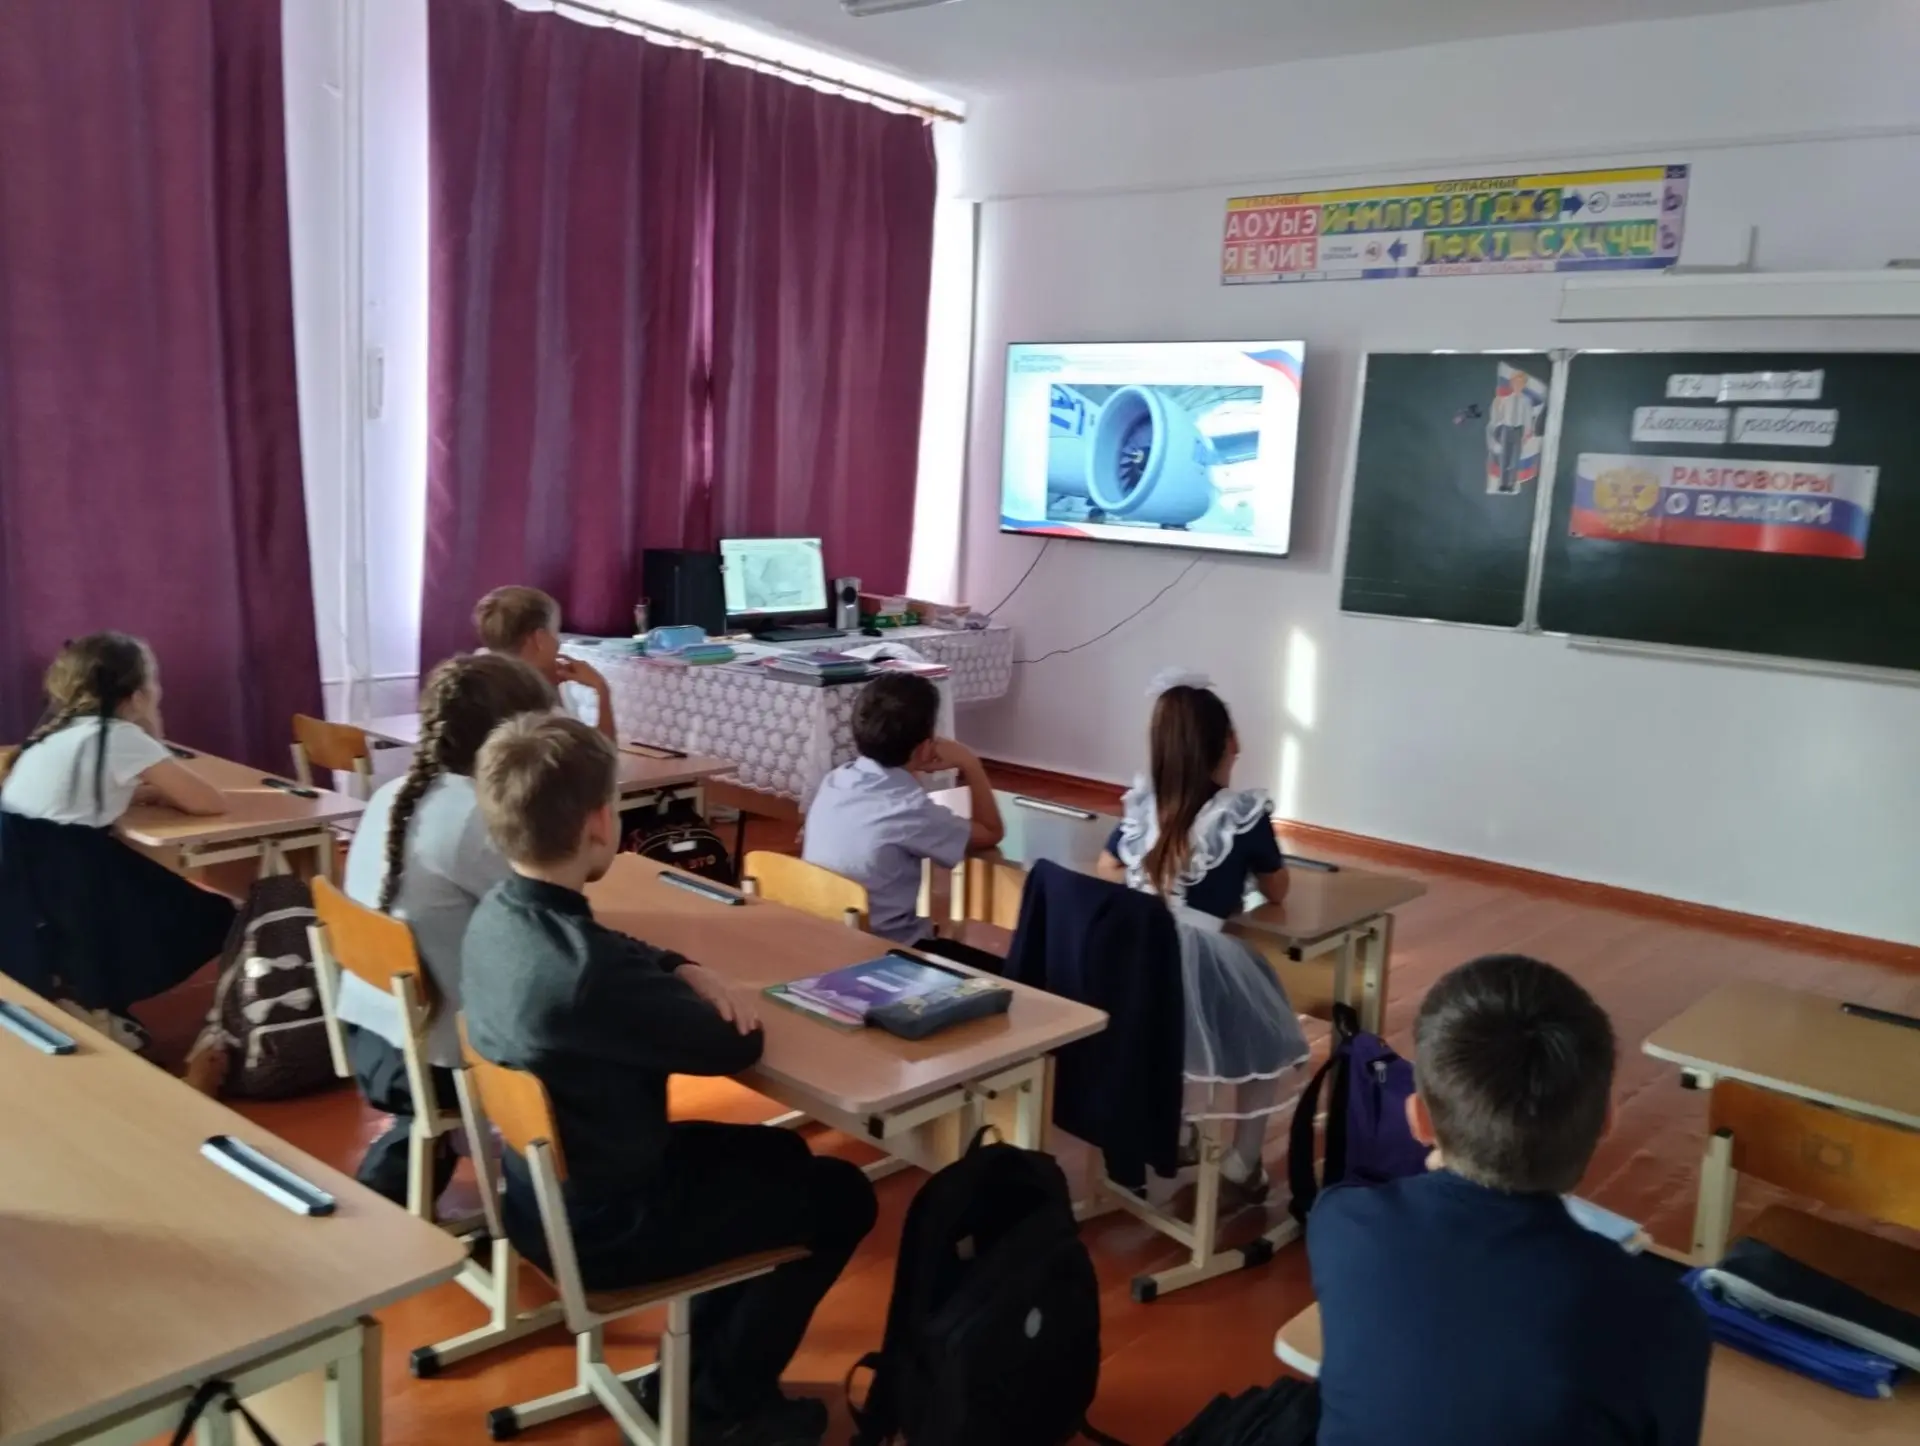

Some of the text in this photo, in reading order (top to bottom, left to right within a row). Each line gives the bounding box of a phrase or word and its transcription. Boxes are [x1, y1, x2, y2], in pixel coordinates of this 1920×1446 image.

[1434, 177, 1519, 193] СОГЛАСНЫЕ
[1671, 466, 1835, 494] РАЗГОВОРЫ
[1665, 492, 1834, 525] О ВАЖНОМ
